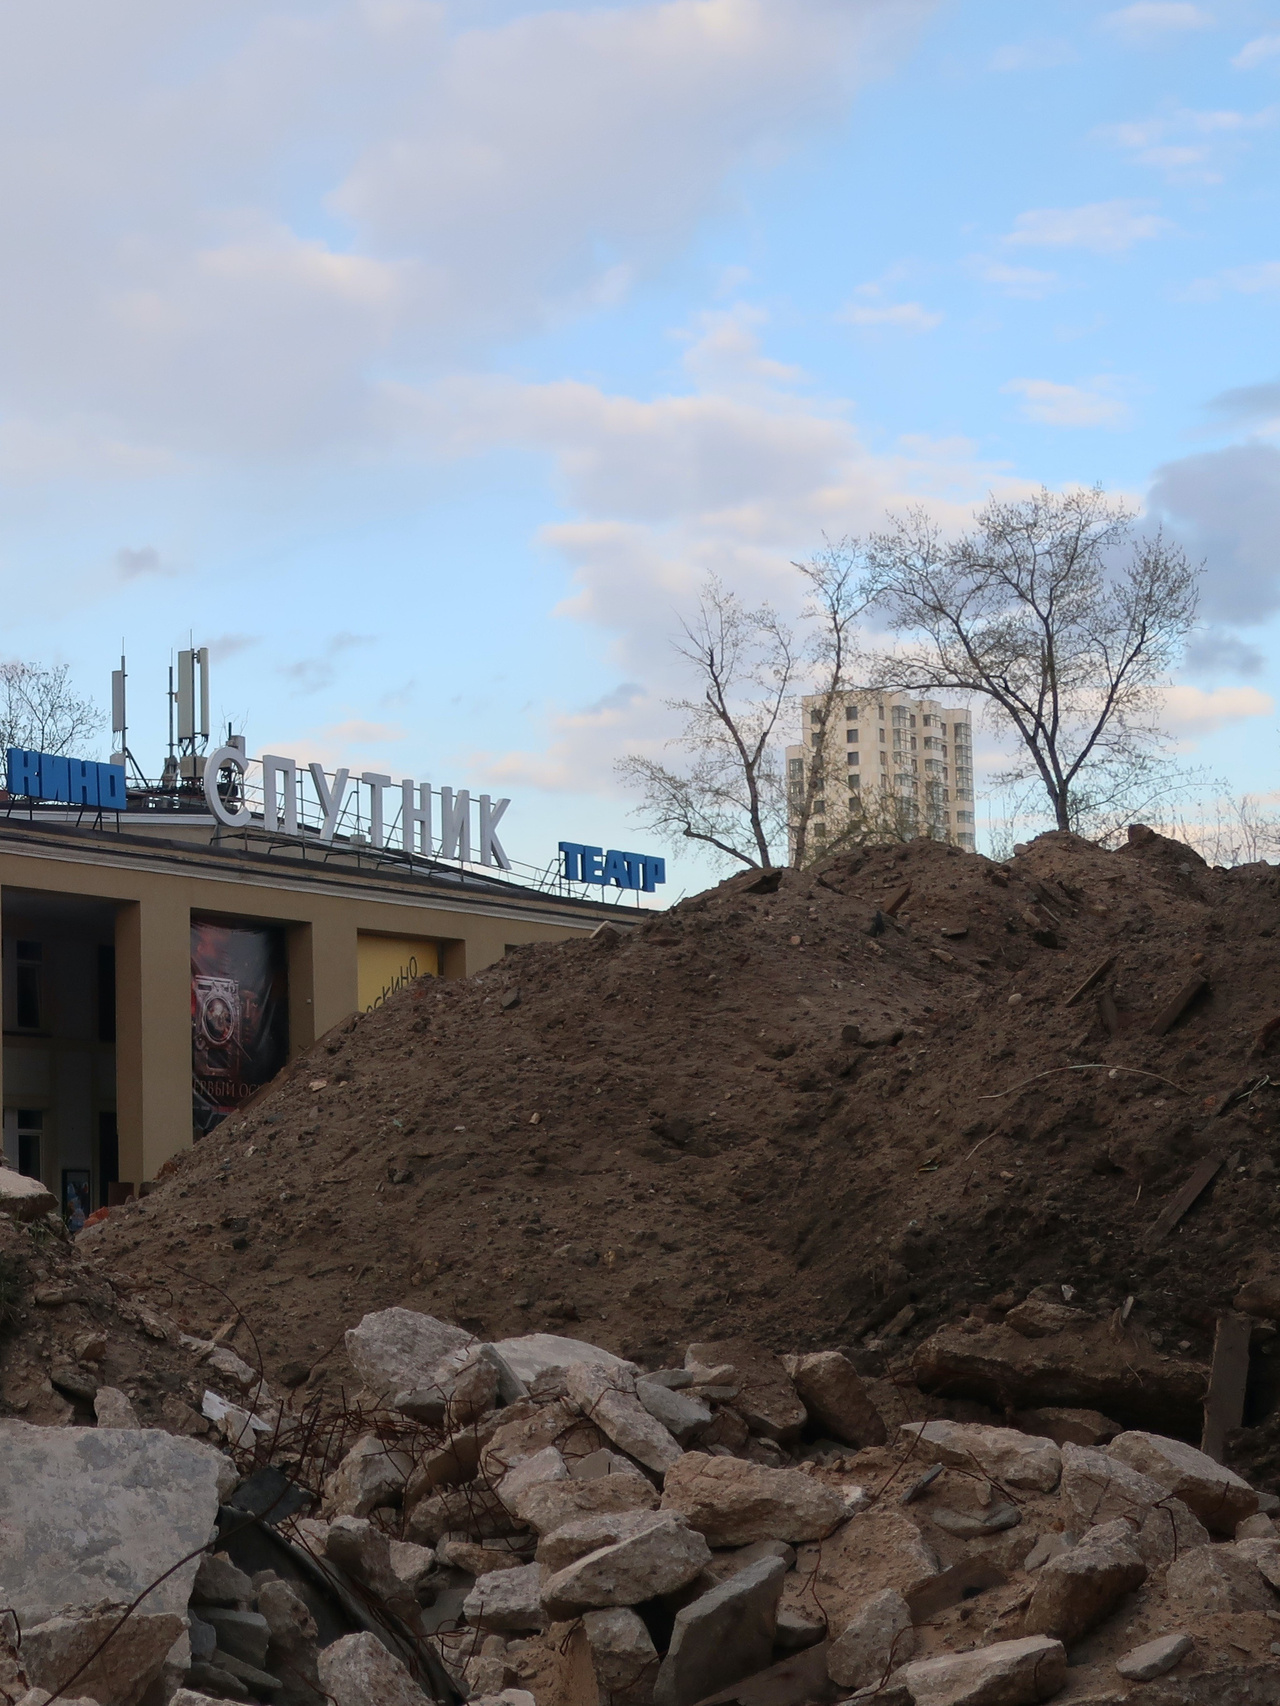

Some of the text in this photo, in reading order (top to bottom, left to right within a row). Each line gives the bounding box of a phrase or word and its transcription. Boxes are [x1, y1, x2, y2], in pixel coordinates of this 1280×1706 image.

[7, 746, 666, 892] КИНО СПУТНИК ТЕАТР
[193, 1079, 262, 1098] ЕРВЫЙ ОС
